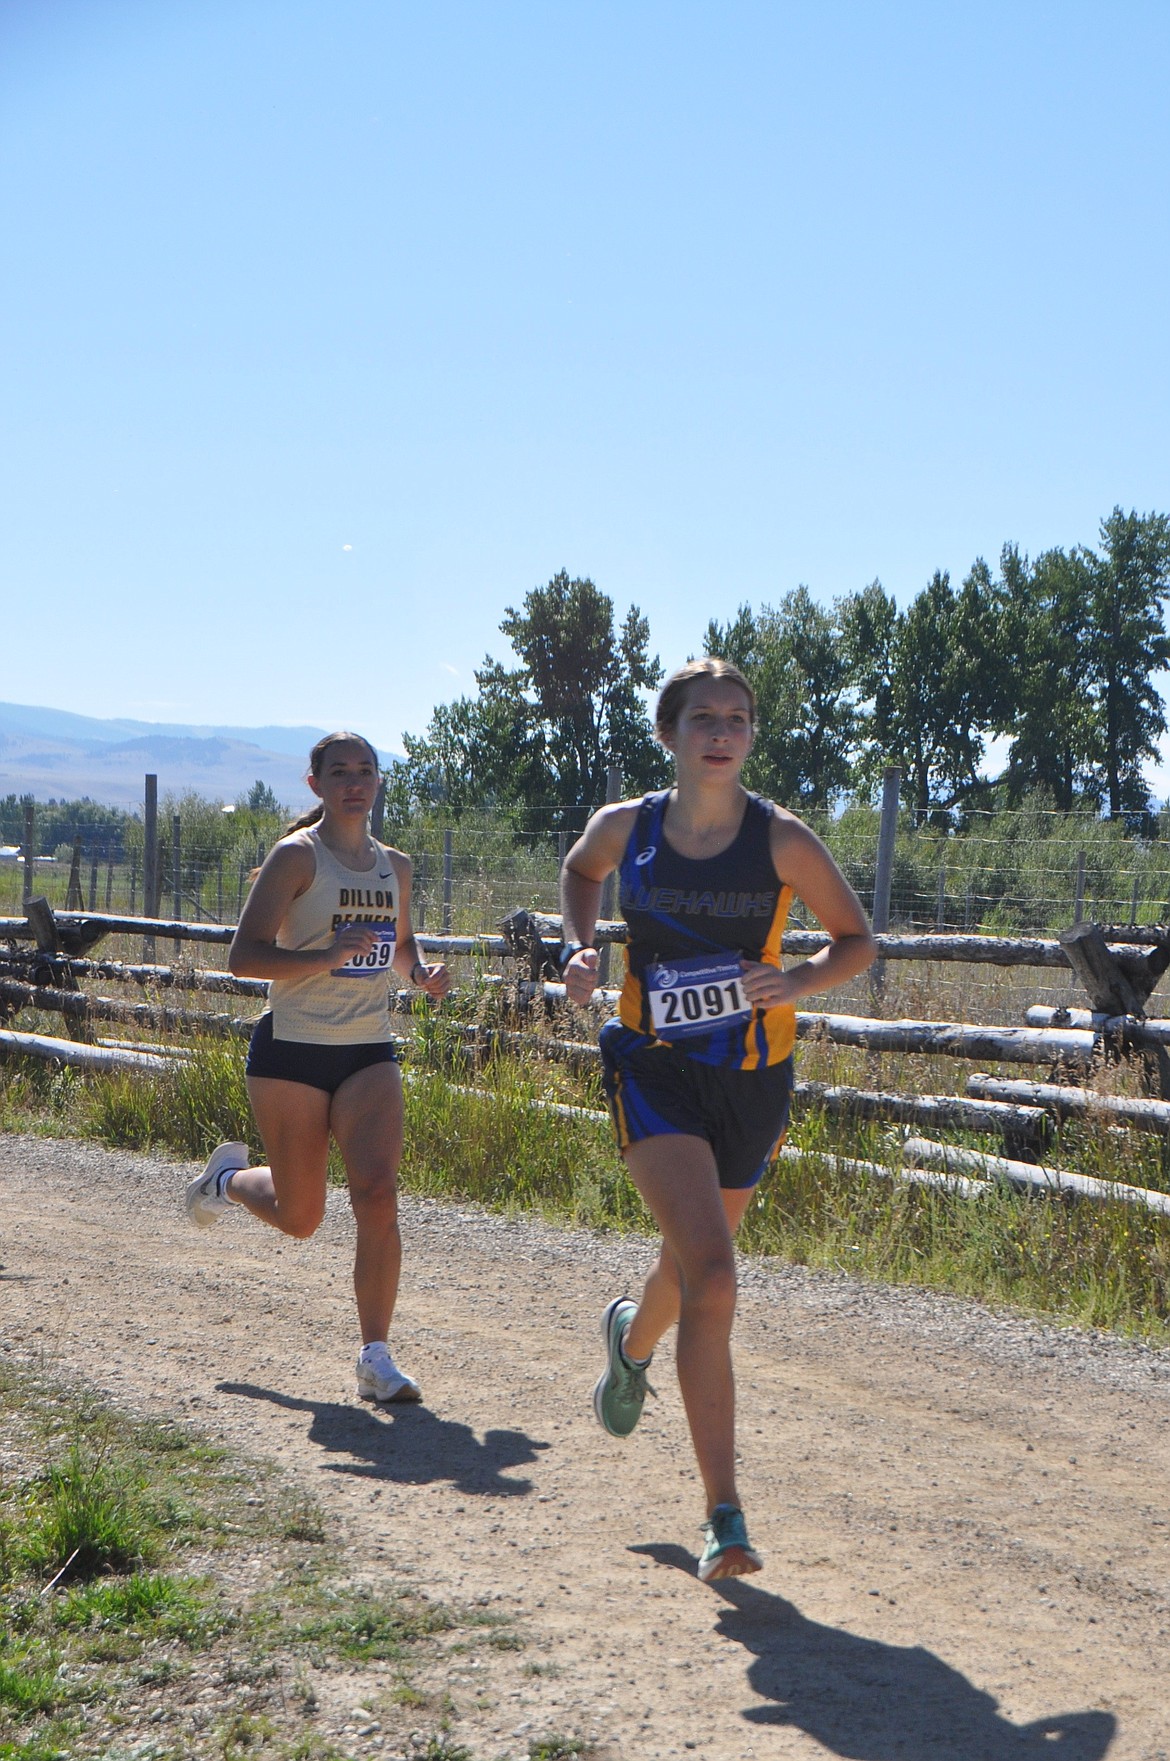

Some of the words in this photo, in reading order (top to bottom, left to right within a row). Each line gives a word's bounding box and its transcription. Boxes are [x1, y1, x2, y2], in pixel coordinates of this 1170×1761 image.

[340, 889, 393, 908] DILLON
[622, 887, 774, 918] LUEHAWKS
[344, 943, 391, 967] 069
[661, 981, 740, 1024] 2091
